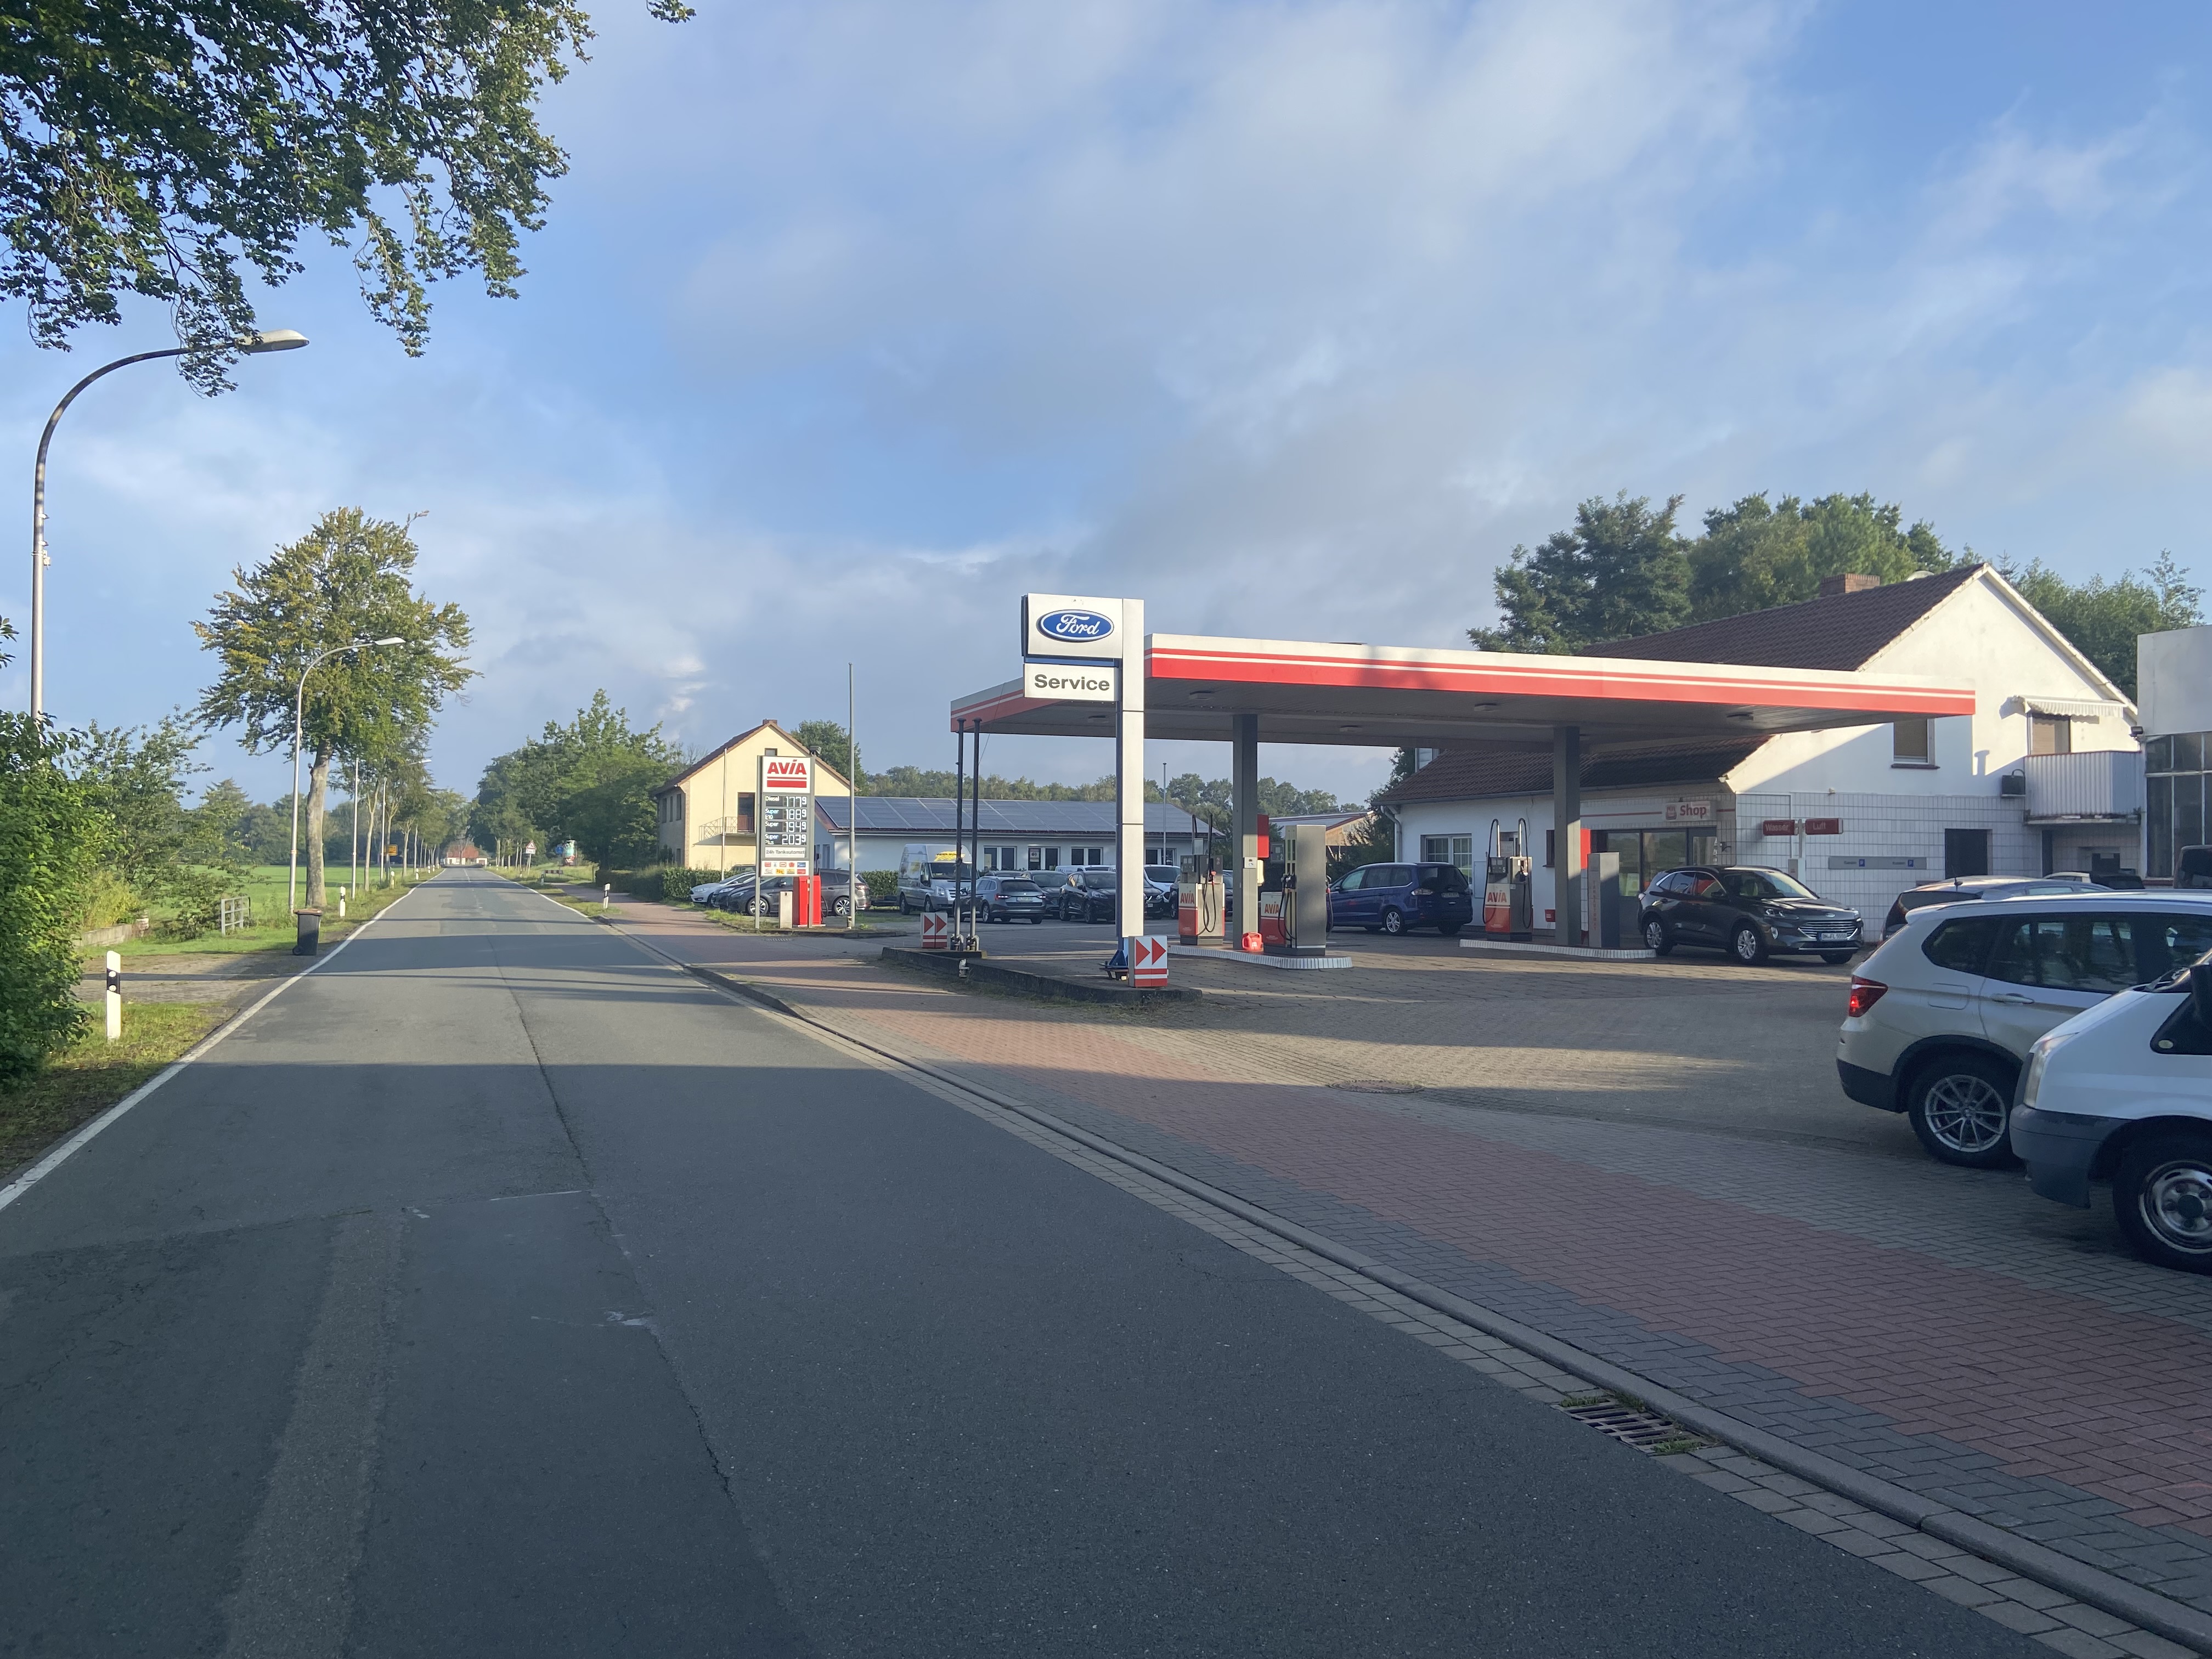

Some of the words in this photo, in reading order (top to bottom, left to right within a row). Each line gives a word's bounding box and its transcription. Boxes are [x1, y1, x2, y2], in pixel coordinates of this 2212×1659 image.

[1056, 614, 1101, 635] Ford
[1034, 674, 1110, 691] Service
[786, 796, 807, 808] 1779
[786, 809, 807, 820] 1889
[1680, 804, 1707, 819] Shop
[785, 821, 806, 832] 1949
[1813, 822, 1826, 830] Luft
[782, 834, 806, 845] 2039
